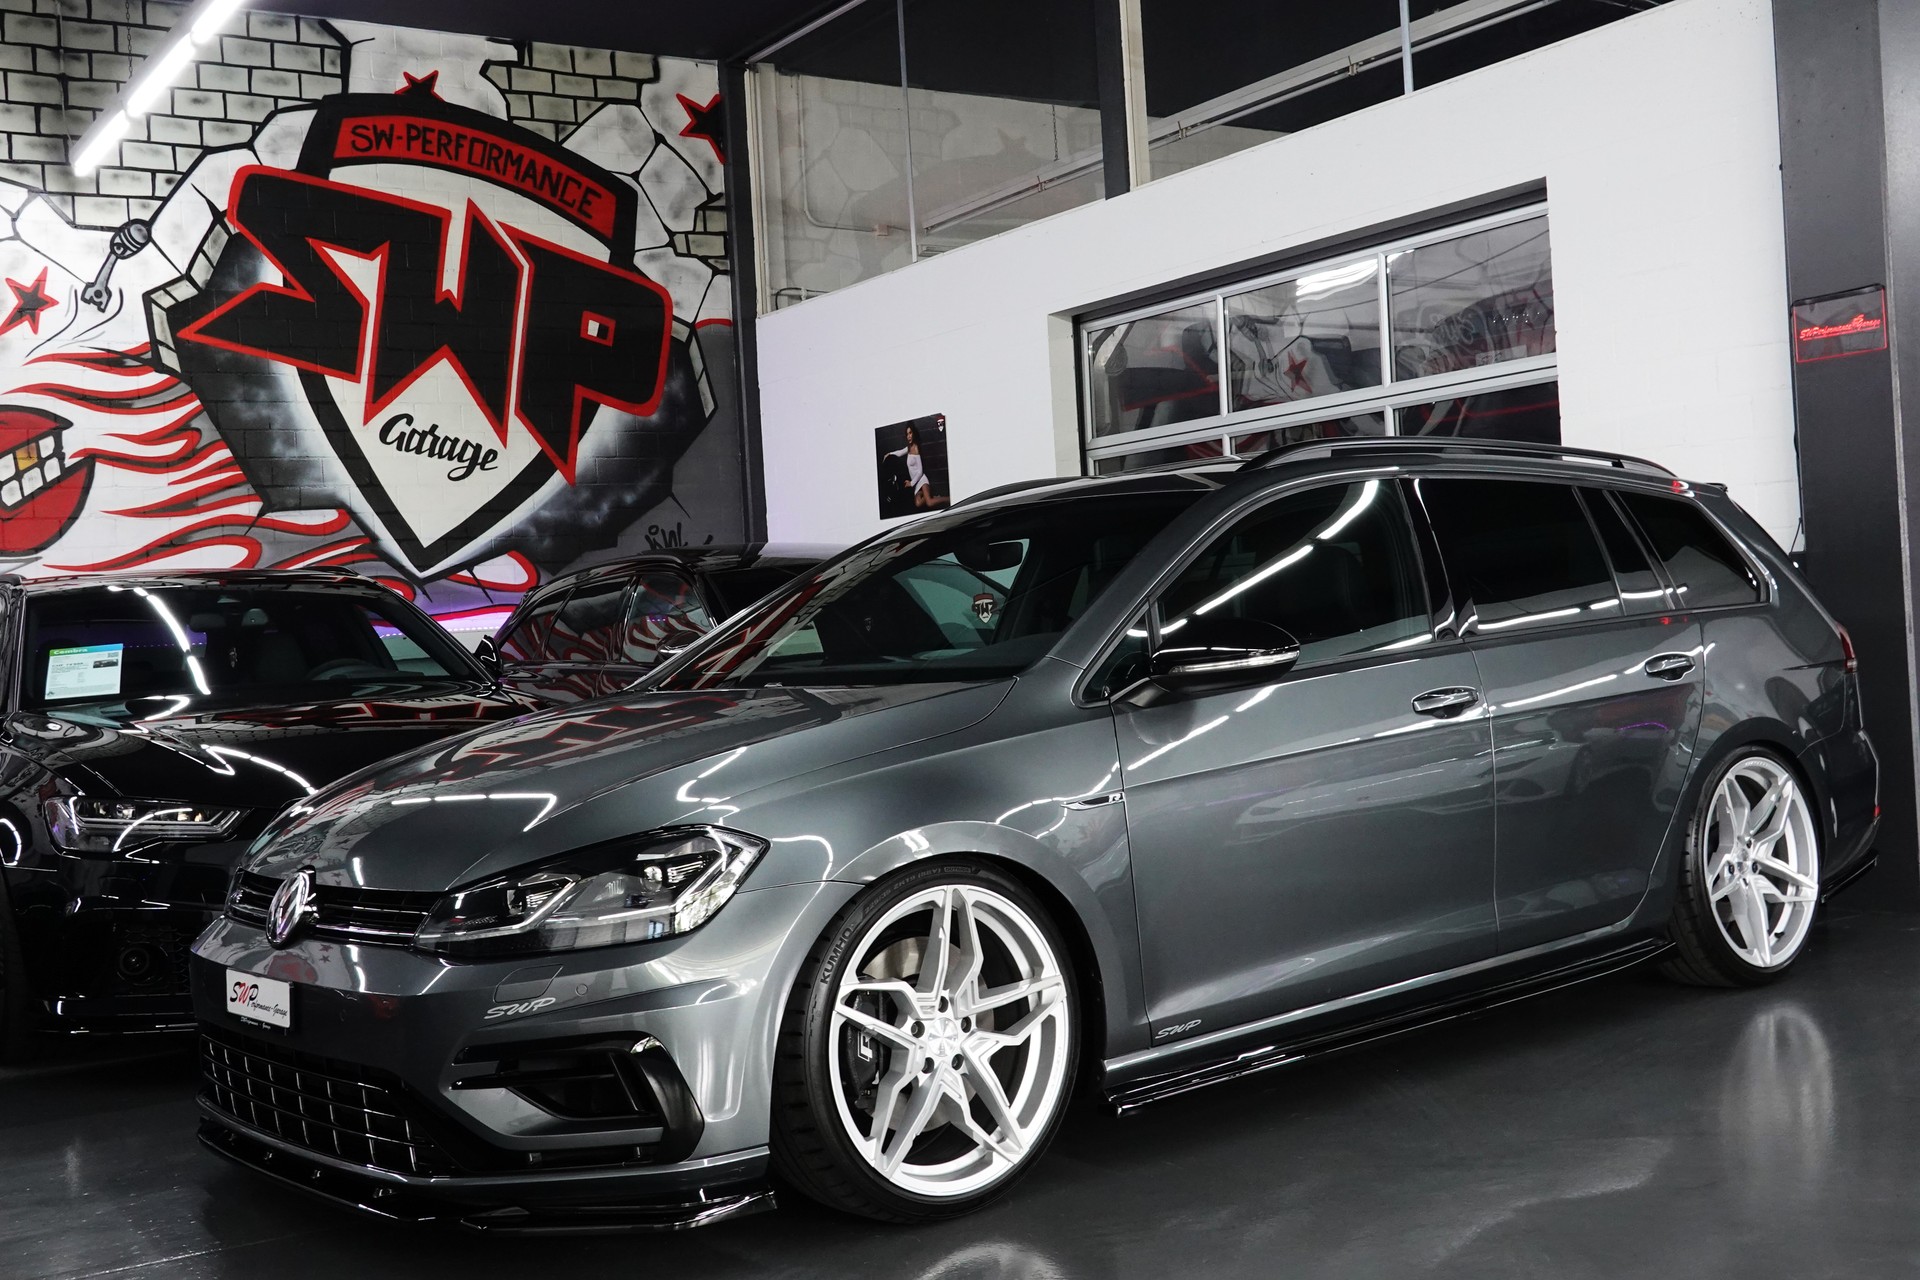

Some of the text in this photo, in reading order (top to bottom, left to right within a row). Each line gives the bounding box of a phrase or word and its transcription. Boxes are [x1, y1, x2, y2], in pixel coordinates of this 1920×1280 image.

[351, 123, 602, 219] SW-PERFORMANCE
[177, 165, 673, 487] SWP
[379, 413, 498, 481] Garage
[820, 927, 853, 985] KUMHO
[484, 997, 556, 1019] SWP
[1155, 1019, 1202, 1039] SWP
